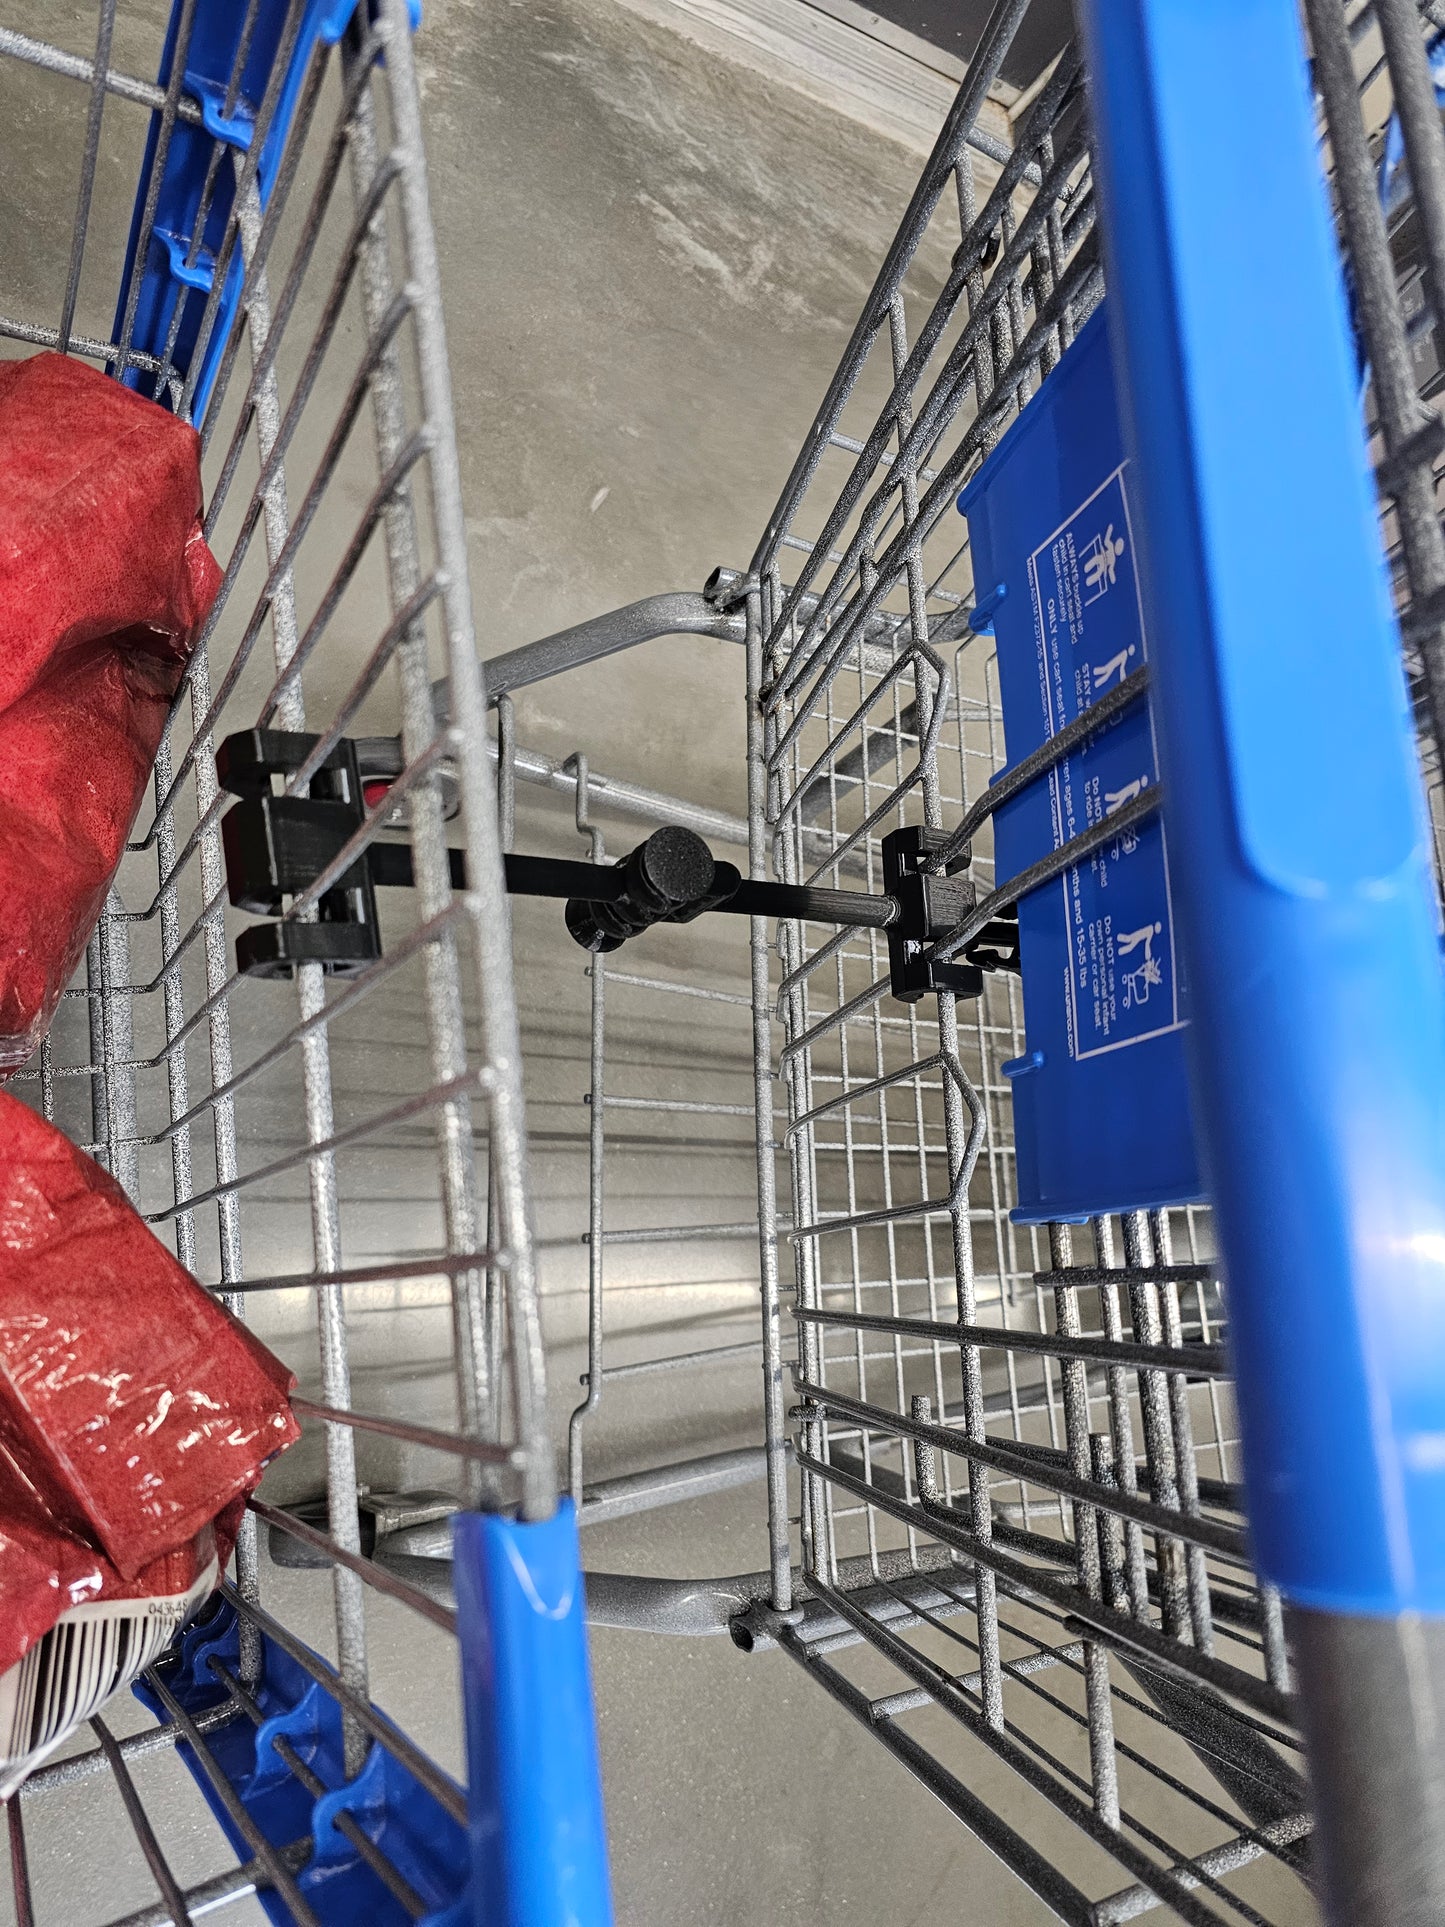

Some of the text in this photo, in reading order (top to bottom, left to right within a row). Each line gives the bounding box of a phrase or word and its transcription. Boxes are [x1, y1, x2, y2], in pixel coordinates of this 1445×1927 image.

[1058, 539, 1067, 562] child
[1026, 557, 1034, 587] Meets
[1052, 543, 1067, 622] fasten securely
[1063, 566, 1069, 576] in
[1066, 532, 1084, 634] ALWAYS buckle up
[1064, 578, 1072, 597] cart
[1030, 588, 1038, 616] ASTM
[1047, 598, 1057, 634] ONLY
[1069, 624, 1077, 644] and
[1054, 663, 1062, 685] cart
[1075, 669, 1083, 695] child
[1082, 663, 1091, 695] STAY
[1040, 682, 1048, 716] Section
[1057, 687, 1066, 712] seat
[1077, 698, 1083, 708] at
[1049, 771, 1057, 796] Lead
[1084, 781, 1091, 794] to
[1092, 776, 1099, 795] Do
[1064, 785, 1073, 816] ages
[1051, 798, 1059, 837] Content
[1074, 899, 1083, 924] and
[1104, 915, 1112, 934] Do
[1077, 928, 1086, 965] 15-35
[1088, 922, 1096, 960] carrier
[1092, 963, 1098, 975] or
[1098, 947, 1107, 999] personal
